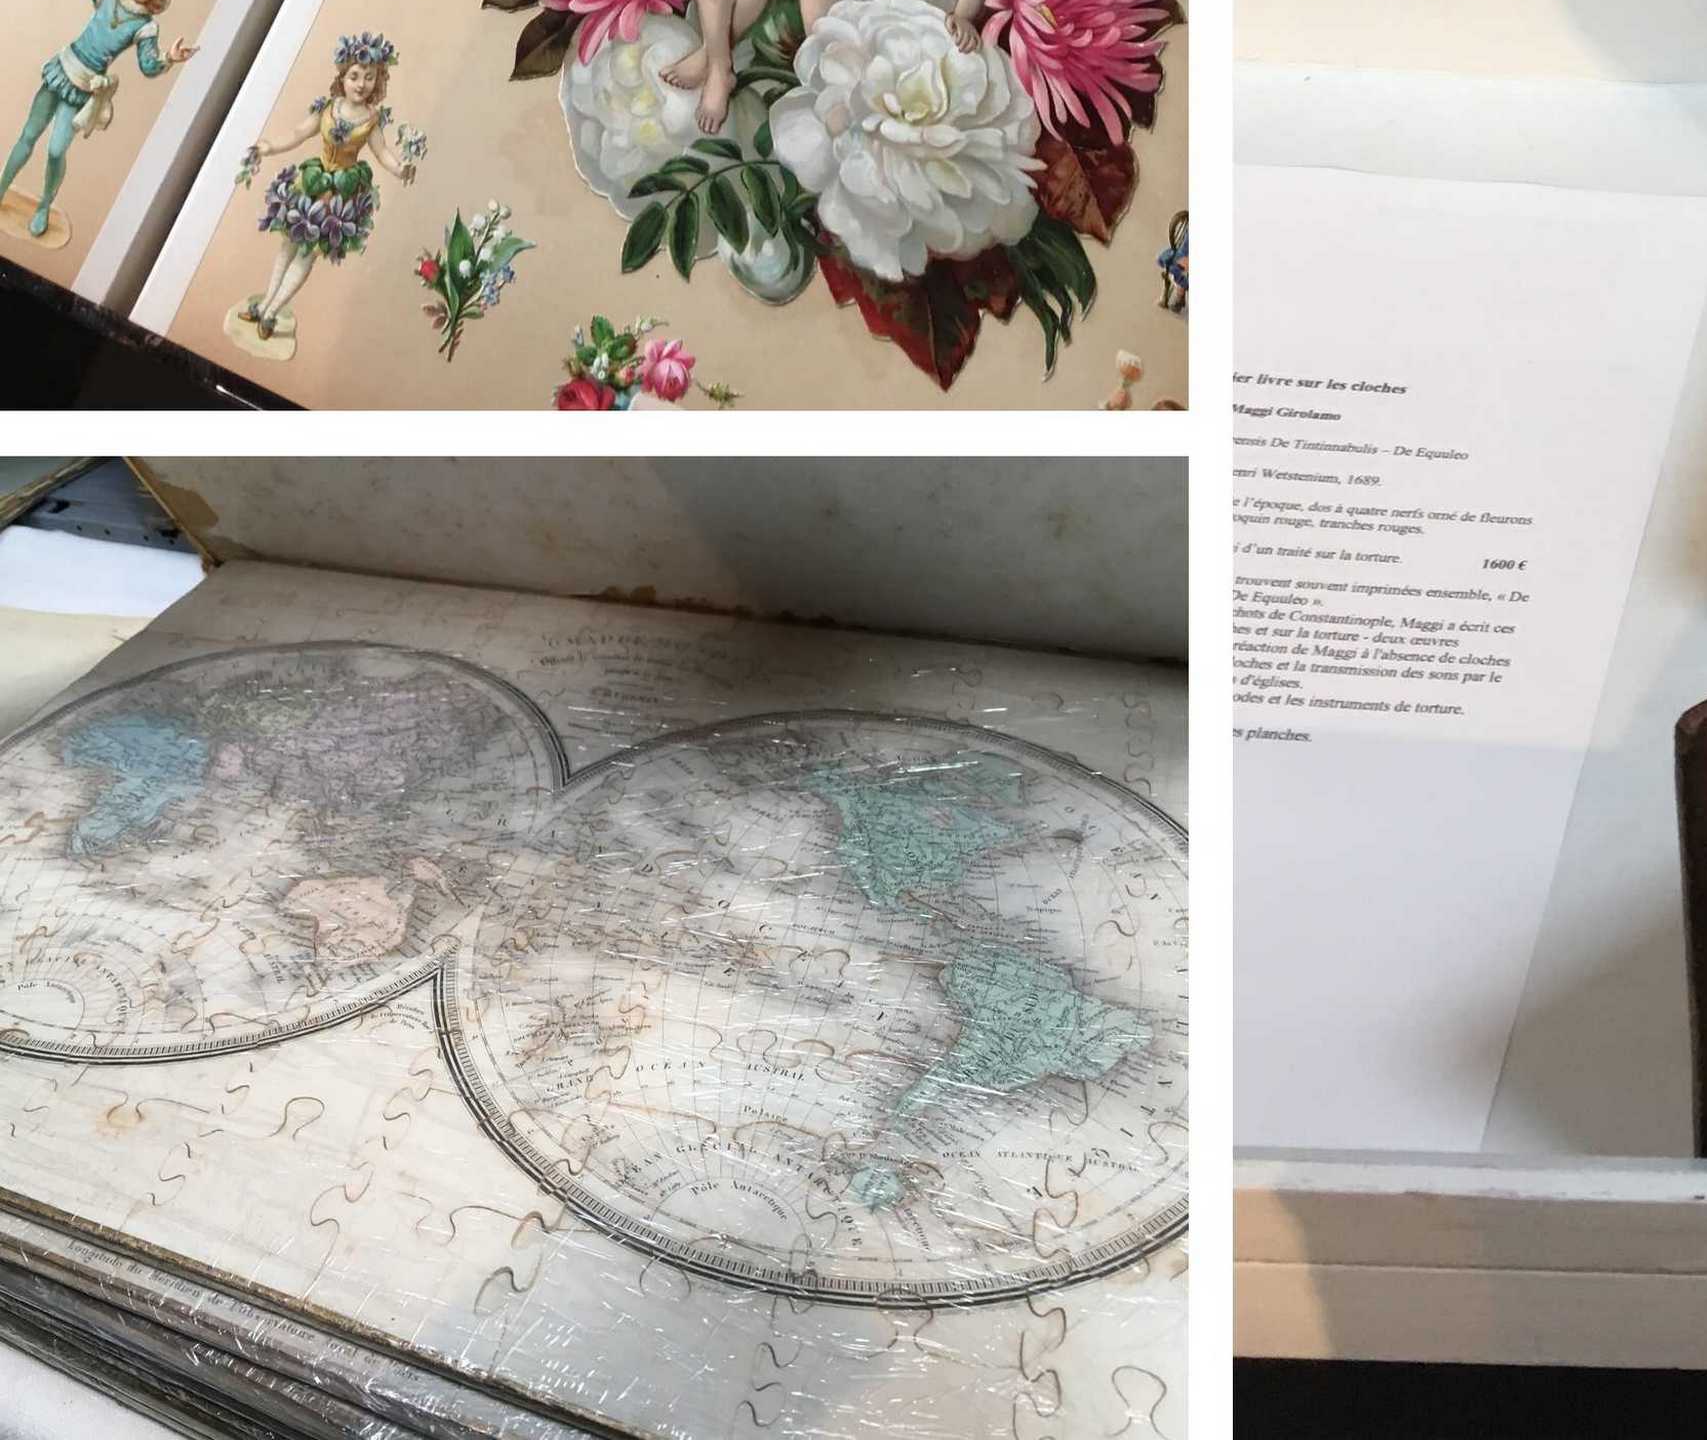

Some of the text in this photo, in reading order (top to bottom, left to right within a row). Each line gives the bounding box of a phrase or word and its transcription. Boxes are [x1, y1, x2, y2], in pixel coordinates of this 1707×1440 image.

[1257, 373, 1407, 394] livre sur les cloches
[1277, 407, 1341, 421] Girolamo
[1271, 437, 1469, 461] De Tintinnabulis De Equuleo
[1347, 474, 1382, 486] 1689.
[1308, 502, 1331, 513] dos
[1347, 506, 1388, 519] quatre
[1391, 507, 1424, 519] nerfs
[1428, 509, 1456, 521] orné
[1480, 512, 1532, 525] fleurons
[1319, 519, 1374, 531] tranches
[1378, 523, 1424, 535] rouges.
[1242, 543, 1403, 564] d'un traité torture.
[1482, 558, 1528, 570] 1600 €
[1235, 576, 1493, 602] trouvent souvent imprimées ensemble,
[1252, 592, 1308, 606] Equuleo
[1289, 611, 1515, 633] Constantinople, Maggi écrit ces
[1314, 630, 1459, 647] torture deux œuvres
[1314, 645, 1357, 660] Maggi
[1373, 649, 1435, 663] l'absence
[1459, 654, 1511, 666] cloches
[1310, 661, 1485, 683] transmission des sons par
[1240, 676, 1303, 690] d'églises.
[1286, 694, 1465, 715] les instruments torture.
[1246, 727, 1311, 742] planches.
